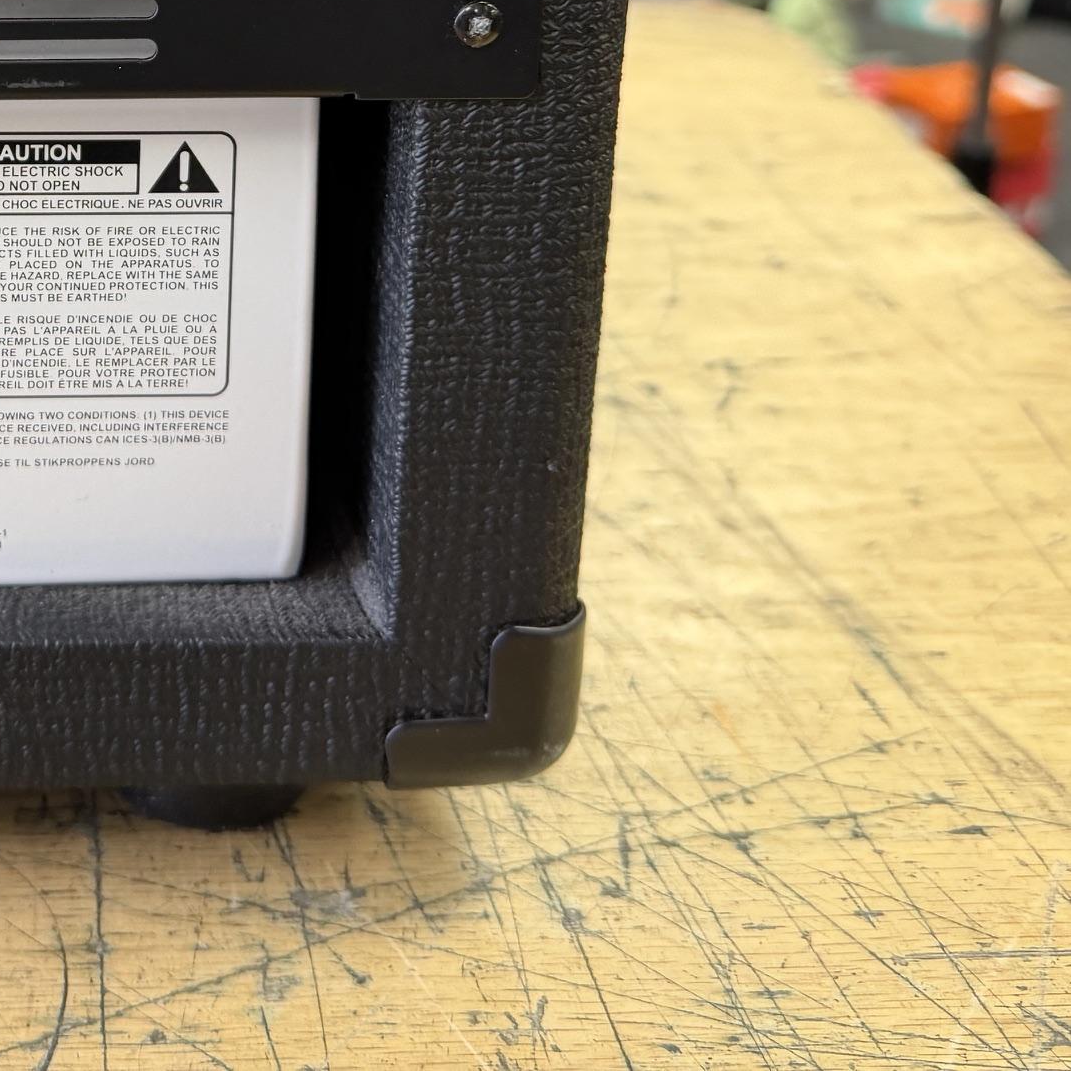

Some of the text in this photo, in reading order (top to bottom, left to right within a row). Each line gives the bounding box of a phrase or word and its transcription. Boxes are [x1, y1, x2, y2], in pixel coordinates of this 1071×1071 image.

[2, 165, 70, 177] ELECTRIC
[74, 165, 123, 176] SHOCK
[9, 179, 37, 193] NOT
[41, 179, 80, 193] OPEN
[2, 199, 37, 209] CHOC
[127, 198, 144, 208] NE
[148, 198, 172, 208] PAS
[175, 198, 222, 208] OUVRIR
[24, 226, 46, 236] THE
[52, 226, 80, 236] RISK
[85, 226, 101, 235] OF
[106, 226, 133, 235] FIRE
[138, 226, 156, 235] OR
[161, 225, 220, 235] ELECTRIC
[3, 237, 52, 247] SHOULD
[57, 237, 81, 247] NOT
[87, 237, 103, 246] BE
[108, 237, 165, 246] EXPOSED
[170, 236, 186, 246] TO
[191, 236, 219, 246] RAIN
[26, 248, 68, 258] FILLED
[73, 248, 103, 257] WITH
[165, 247, 198, 257] SUCH
[202, 247, 219, 257] AS
[9, 260, 57, 269] PLACED
[65, 259, 82, 269] ON
[91, 259, 113, 268] THE
[203, 258, 219, 268] TO
[66, 270, 121, 280] REPLACE
[125, 270, 155, 279] WITH
[158, 270, 181, 279] THE
[185, 270, 218, 279] SAME
[11, 293, 44, 302] MUST
[47, 292, 63, 302] BE
[66, 292, 126, 302] EARTHED!
